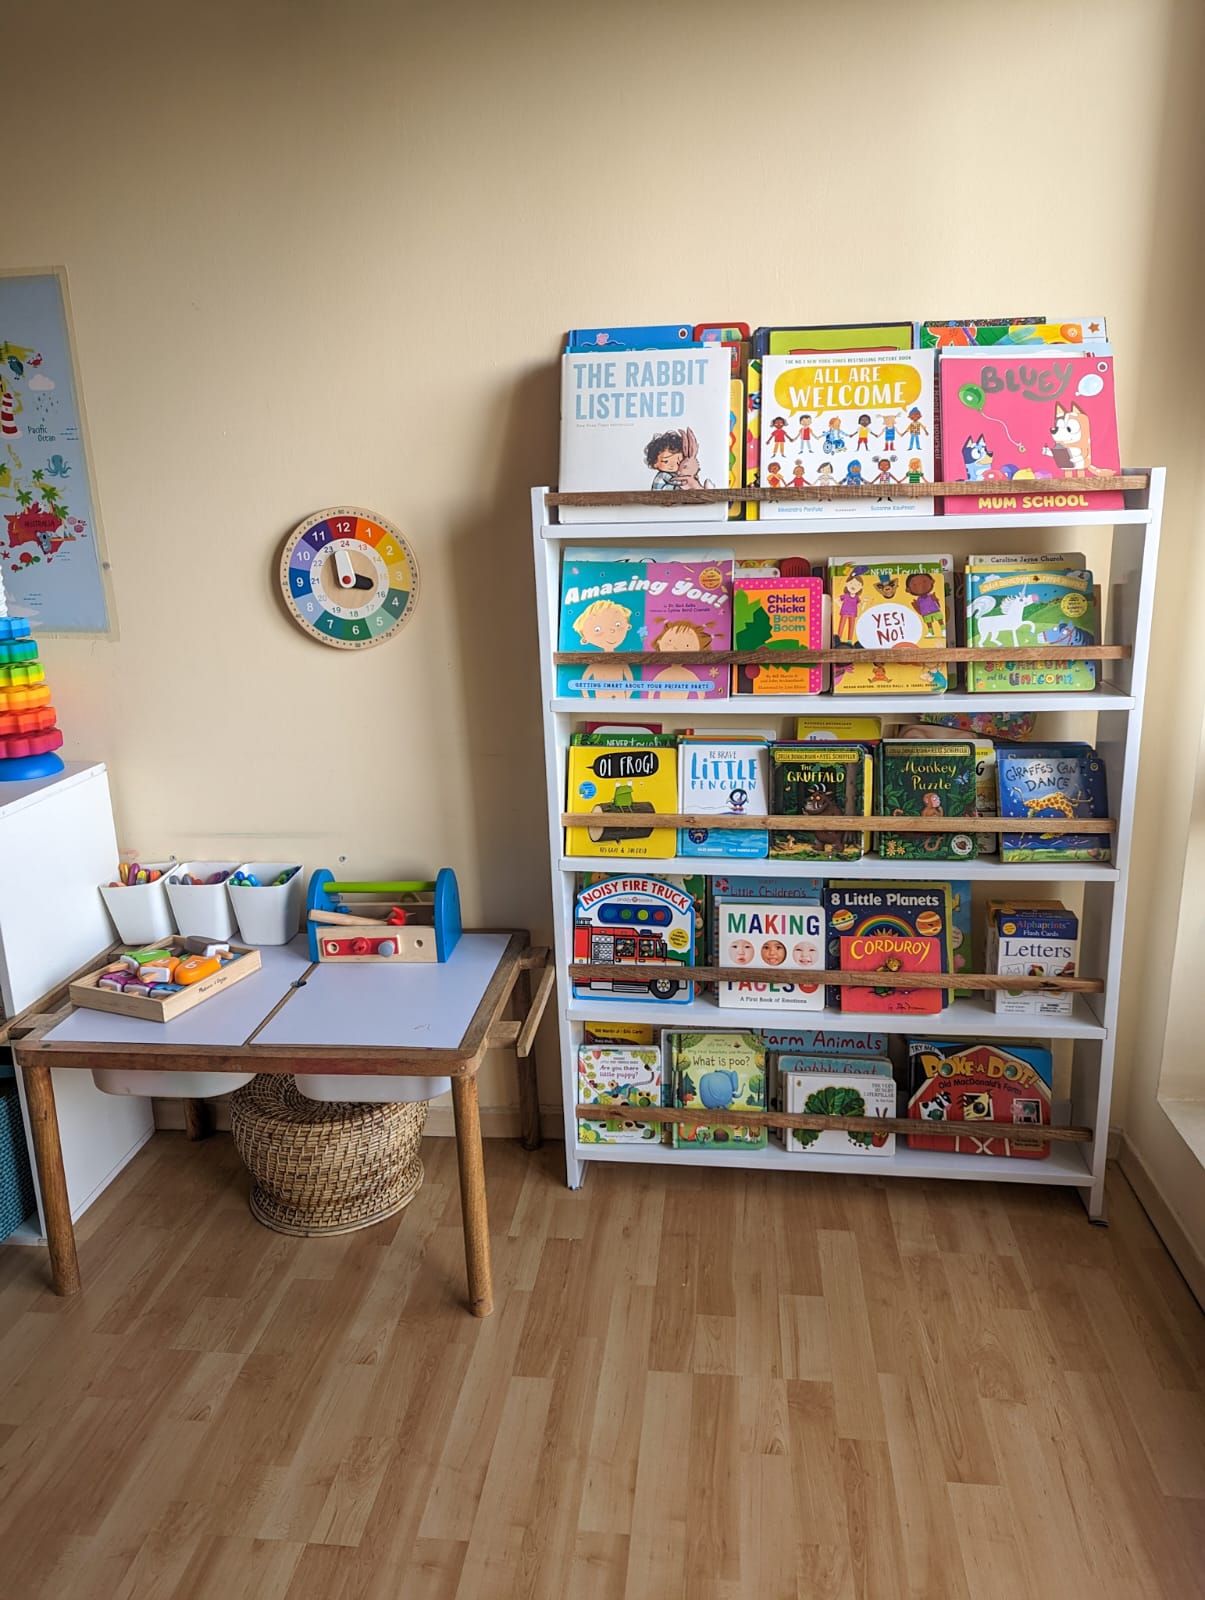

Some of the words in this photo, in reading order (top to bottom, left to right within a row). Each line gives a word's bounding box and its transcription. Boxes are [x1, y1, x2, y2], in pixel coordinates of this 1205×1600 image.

[573, 362, 617, 389] THE
[625, 359, 709, 387] RABBIT
[814, 368, 842, 384] ALL
[849, 366, 881, 383] ARE
[980, 362, 1073, 402] BLUEY
[788, 381, 907, 409] WELCOME
[576, 392, 685, 420] LISTENED
[28, 424, 47, 434] Pacific
[978, 496, 1017, 509] MUM
[1022, 494, 1088, 508] SCHOOL
[336, 522, 350, 533] 12
[366, 528, 371, 538] 1
[312, 531, 326, 541] 11
[297, 551, 310, 560] 10
[386, 546, 393, 555] 2
[296, 577, 304, 587] 9
[396, 571, 402, 581] 3
[564, 576, 669, 605] Amazing
[671, 580, 729, 608] You!
[392, 597, 399, 606] 4
[767, 595, 806, 604] Chicka
[306, 602, 314, 612] 8
[767, 604, 806, 613] Chicka
[327, 620, 334, 629] 7
[376, 617, 383, 626] 5
[773, 614, 806, 623] Boom
[871, 612, 905, 628] YES!
[352, 625, 360, 635] 6
[773, 624, 806, 632] Boom
[876, 626, 905, 645] NO!
[1009, 673, 1074, 686] Unicorn
[620, 753, 654, 774] FROG!
[901, 761, 956, 777] Monkey
[787, 771, 844, 783] GRUFFALO
[1005, 763, 1053, 782] GIRAFFES
[691, 780, 756, 790] PENGUIN
[912, 777, 952, 791] Puzzle
[1024, 777, 1070, 792] DANCE
[582, 882, 619, 905] NOISY
[622, 880, 648, 892] FIRE
[652, 883, 689, 909] TRUCK
[730, 886, 754, 896] Little
[759, 886, 806, 896] Children's
[831, 893, 840, 905] 8
[844, 893, 882, 905] Little
[886, 893, 939, 906] Planets
[728, 913, 820, 936] MAKING
[850, 939, 931, 964] CORDUROY
[1004, 941, 1071, 958] Letters
[813, 1030, 881, 1050] Animals
[693, 1056, 715, 1065] What
[719, 1056, 726, 1065] is
[729, 1056, 750, 1069] poo?
[954, 1080, 1001, 1088] MacDonald's
[1003, 1084, 1022, 1094] Farm
